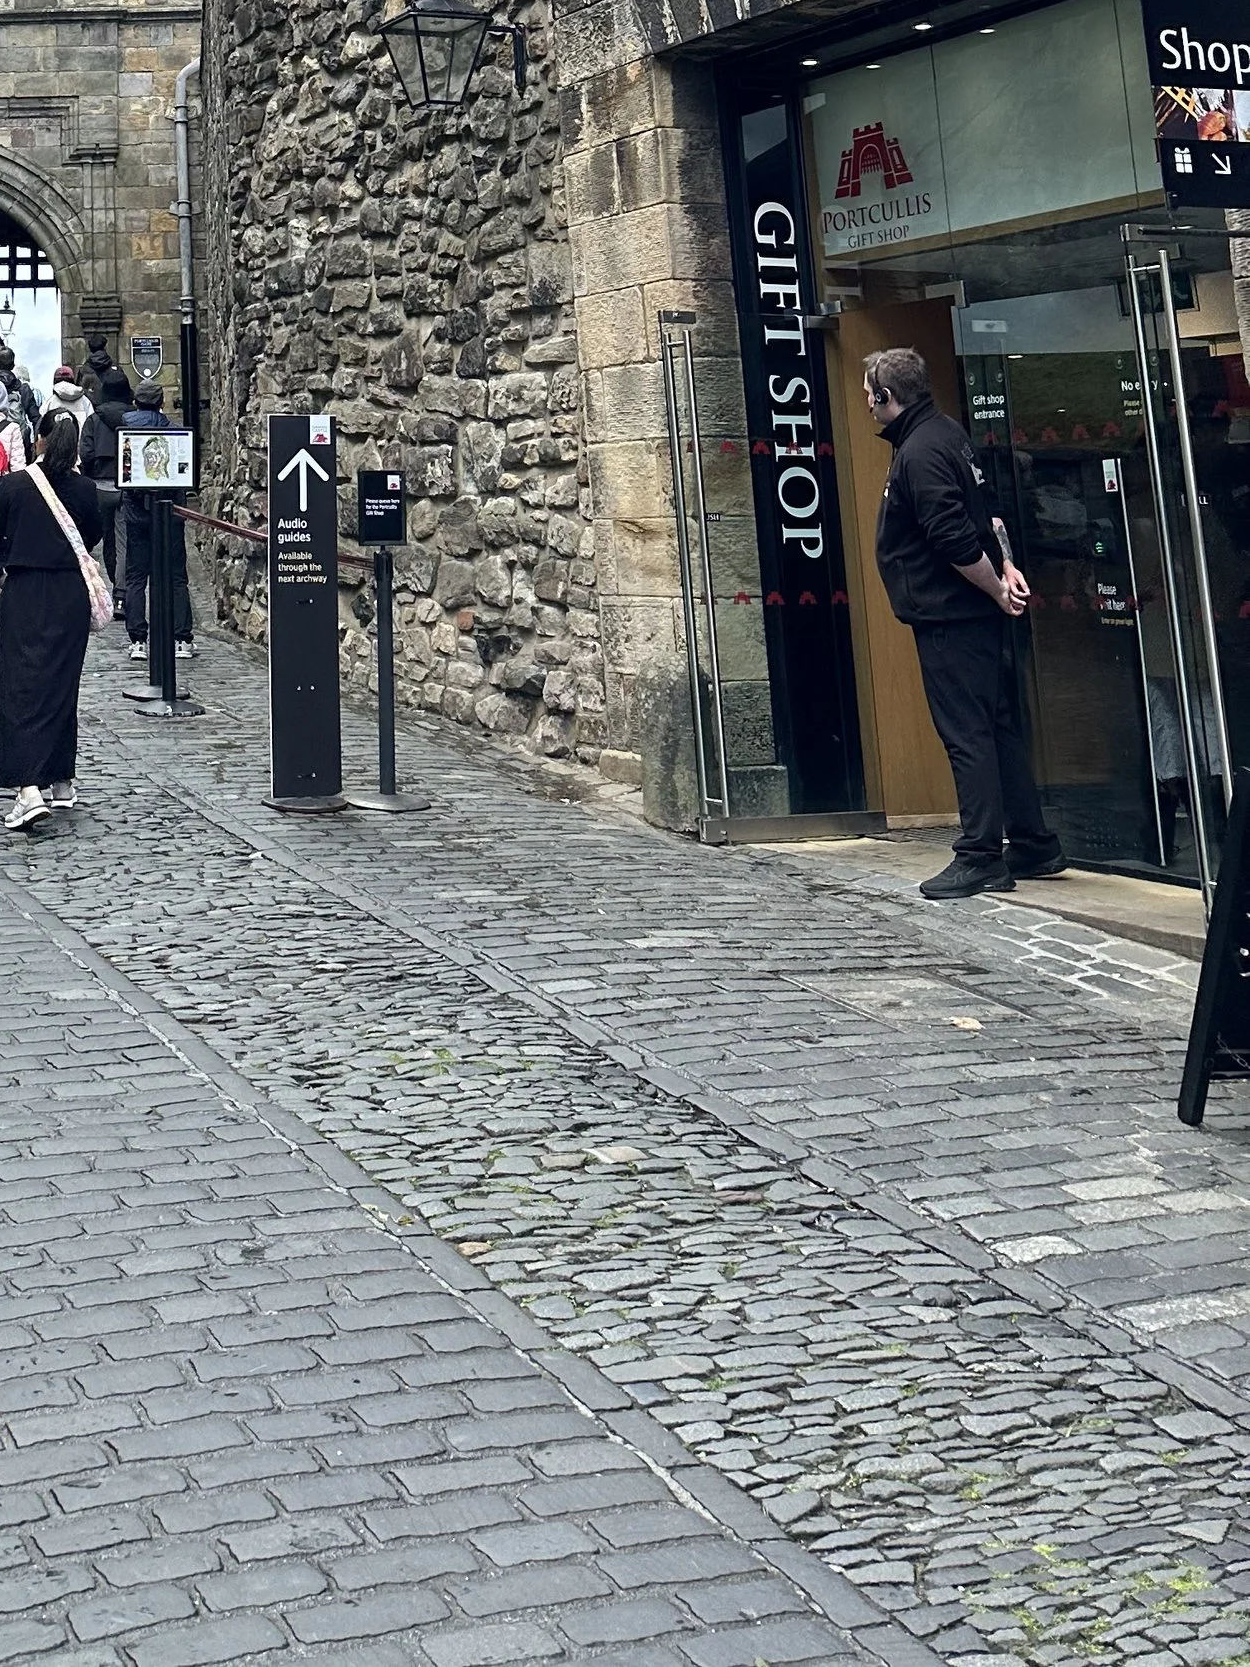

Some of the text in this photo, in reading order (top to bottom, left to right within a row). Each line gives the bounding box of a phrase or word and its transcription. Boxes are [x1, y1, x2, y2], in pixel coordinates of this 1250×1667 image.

[1159, 27, 1250, 85] Shop
[823, 193, 932, 234] PORTCULLIS
[847, 224, 910, 249] GIFT SHOP
[754, 202, 824, 559] GIFT SHOP
[1120, 380, 1133, 391] No
[972, 394, 1005, 405] Gift shop
[973, 410, 1005, 420] entrance
[277, 518, 307, 529] Audio
[277, 531, 311, 544] guides
[278, 552, 312, 560] Available
[277, 563, 323, 573] through the
[277, 575, 328, 584] next archway
